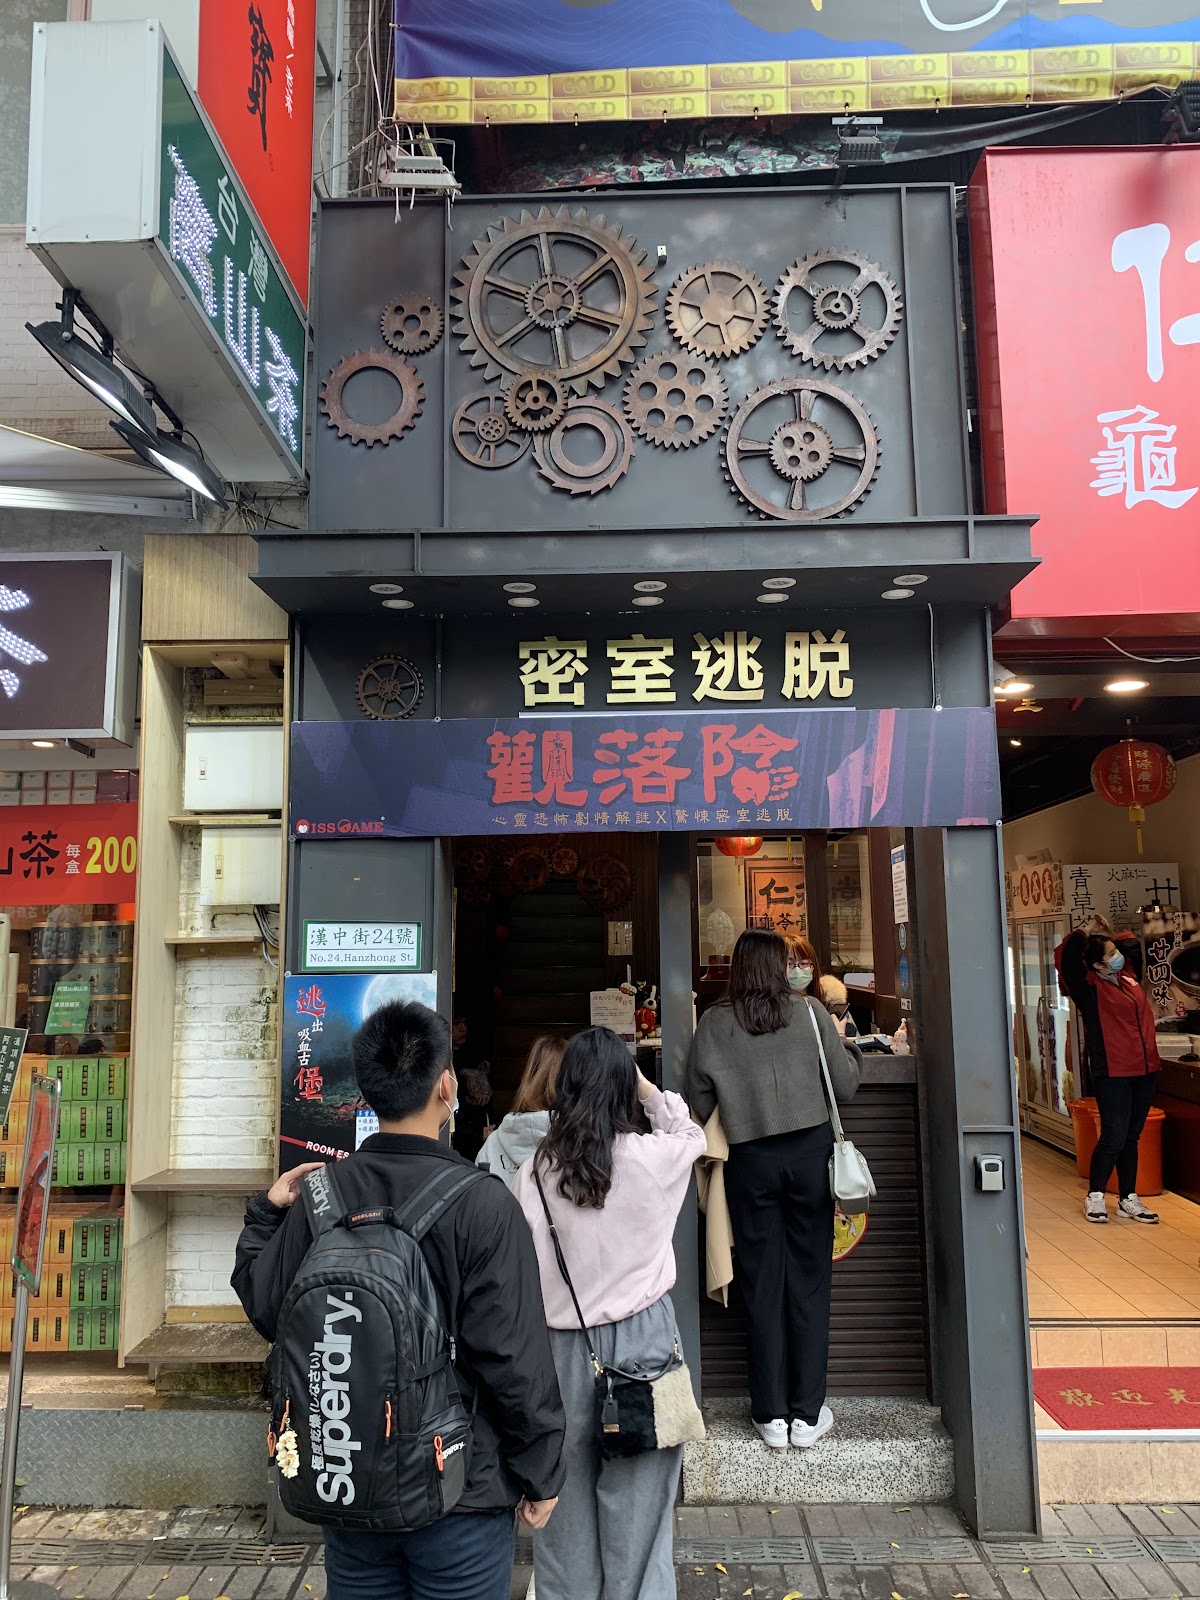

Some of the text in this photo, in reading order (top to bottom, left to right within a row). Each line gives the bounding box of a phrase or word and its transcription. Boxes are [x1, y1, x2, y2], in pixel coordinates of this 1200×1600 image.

[407, 45, 1181, 98] GOLD GOLD GOLD GOLD GOLD GOLD GOLD GOLD GOLD GOLD
[407, 104, 459, 121] GOLD
[484, 103, 537, 120] GOLD
[562, 99, 616, 118] GOLD
[641, 94, 695, 114] GOLD
[720, 91, 774, 112] GOLD
[801, 89, 855, 109] GOLD
[881, 84, 936, 104] GOLD
[962, 79, 1017, 100] GOLD
[1044, 77, 1099, 98] GOLD
[217, 175, 269, 303] 台灣
[1089, 404, 1199, 509] 龜
[65, 843, 81, 874] 每盒
[85, 835, 137, 874] 200
[1107, 867, 1148, 882] 火麻仁
[310, 927, 415, 947] 漢中街24號
[310, 952, 414, 963] No.24,Hanzhong St.
[306, 1140, 350, 1160] ROOM ES
[314, 1291, 362, 1506] Superdry.
